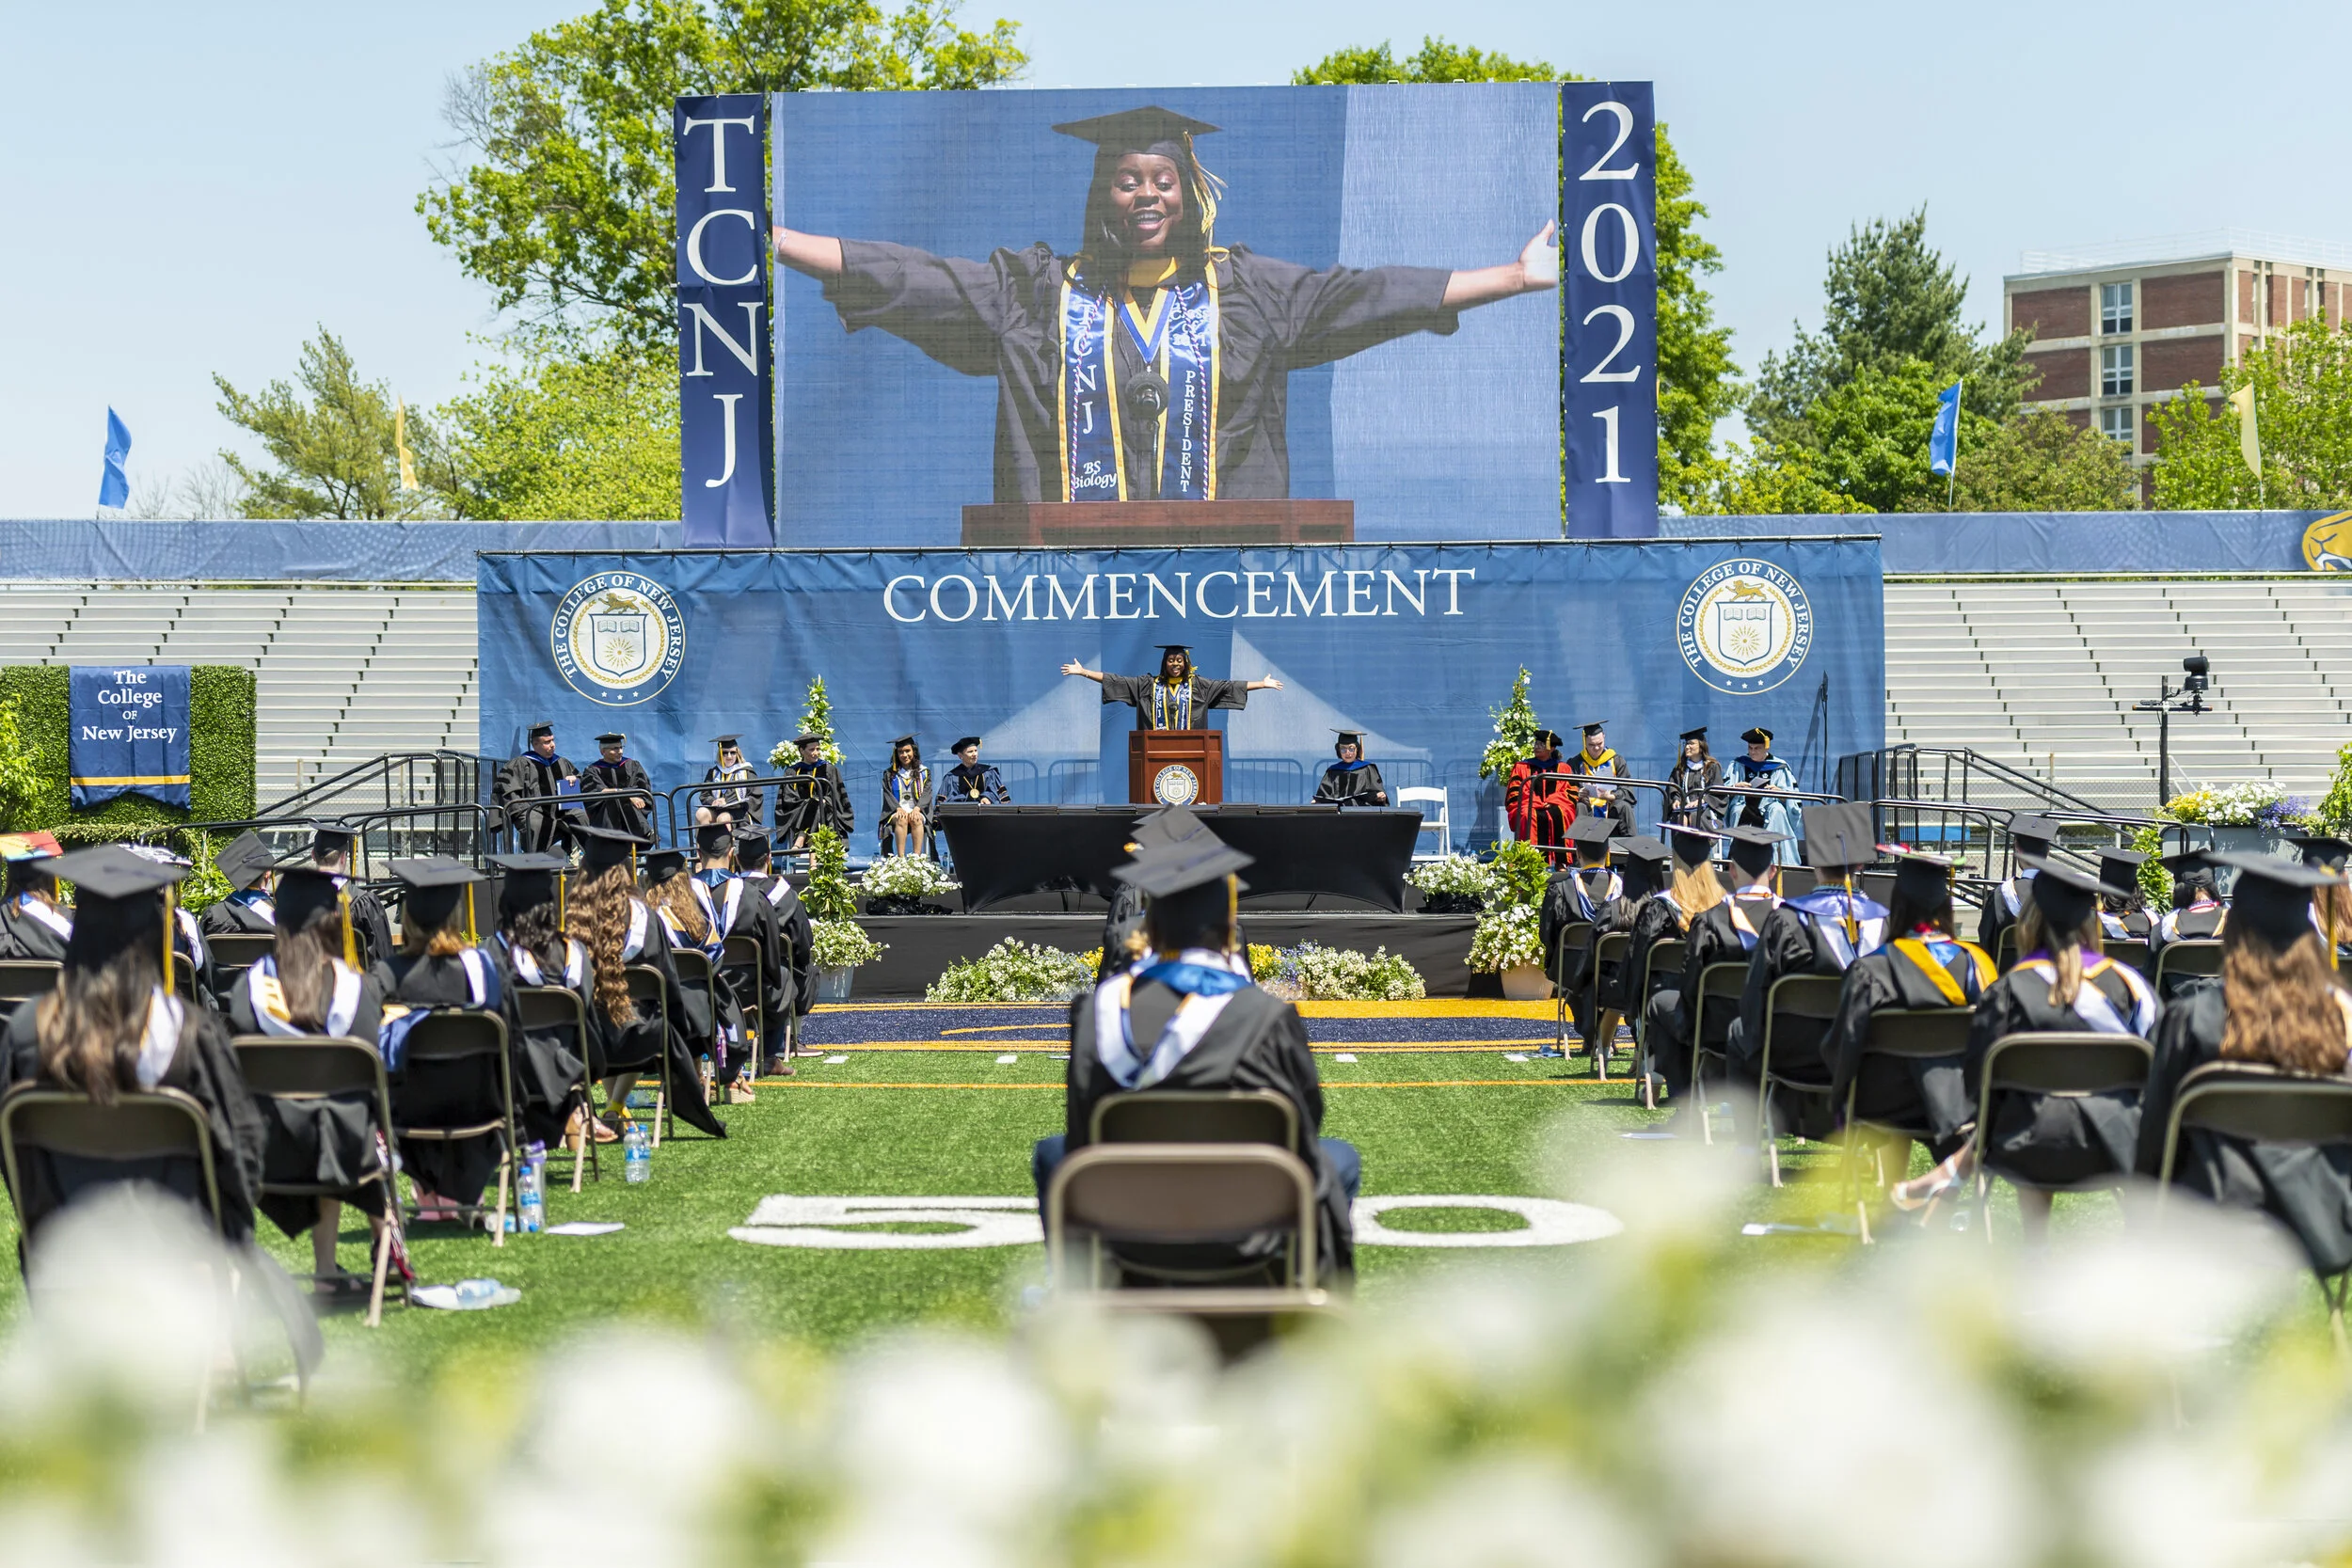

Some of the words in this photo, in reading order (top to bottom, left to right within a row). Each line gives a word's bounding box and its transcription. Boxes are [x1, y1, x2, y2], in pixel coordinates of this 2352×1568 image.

[683, 115, 764, 488] TCNJ
[1579, 100, 1641, 483] 2021
[1181, 370, 1197, 492] PRESIDENT
[1073, 471, 1118, 489] Biology
[1083, 460, 1102, 475] BS
[612, 575, 635, 588] OF
[1738, 562, 1762, 575] OF
[1764, 566, 1801, 598] NEW
[555, 577, 608, 639] COLLEGE
[637, 579, 674, 610] NEW
[882, 567, 1476, 623] COMMENCEMENT
[1681, 563, 1735, 627] COLLEGE
[660, 616, 682, 679] JERSEY
[1681, 631, 1703, 668] THE
[1787, 602, 1809, 668] JERSEY
[555, 643, 578, 678] THE
[113, 670, 148, 685] The
[98, 689, 163, 708] College
[122, 710, 137, 721] OF
[82, 725, 123, 740] New
[126, 725, 178, 743] Jersey
